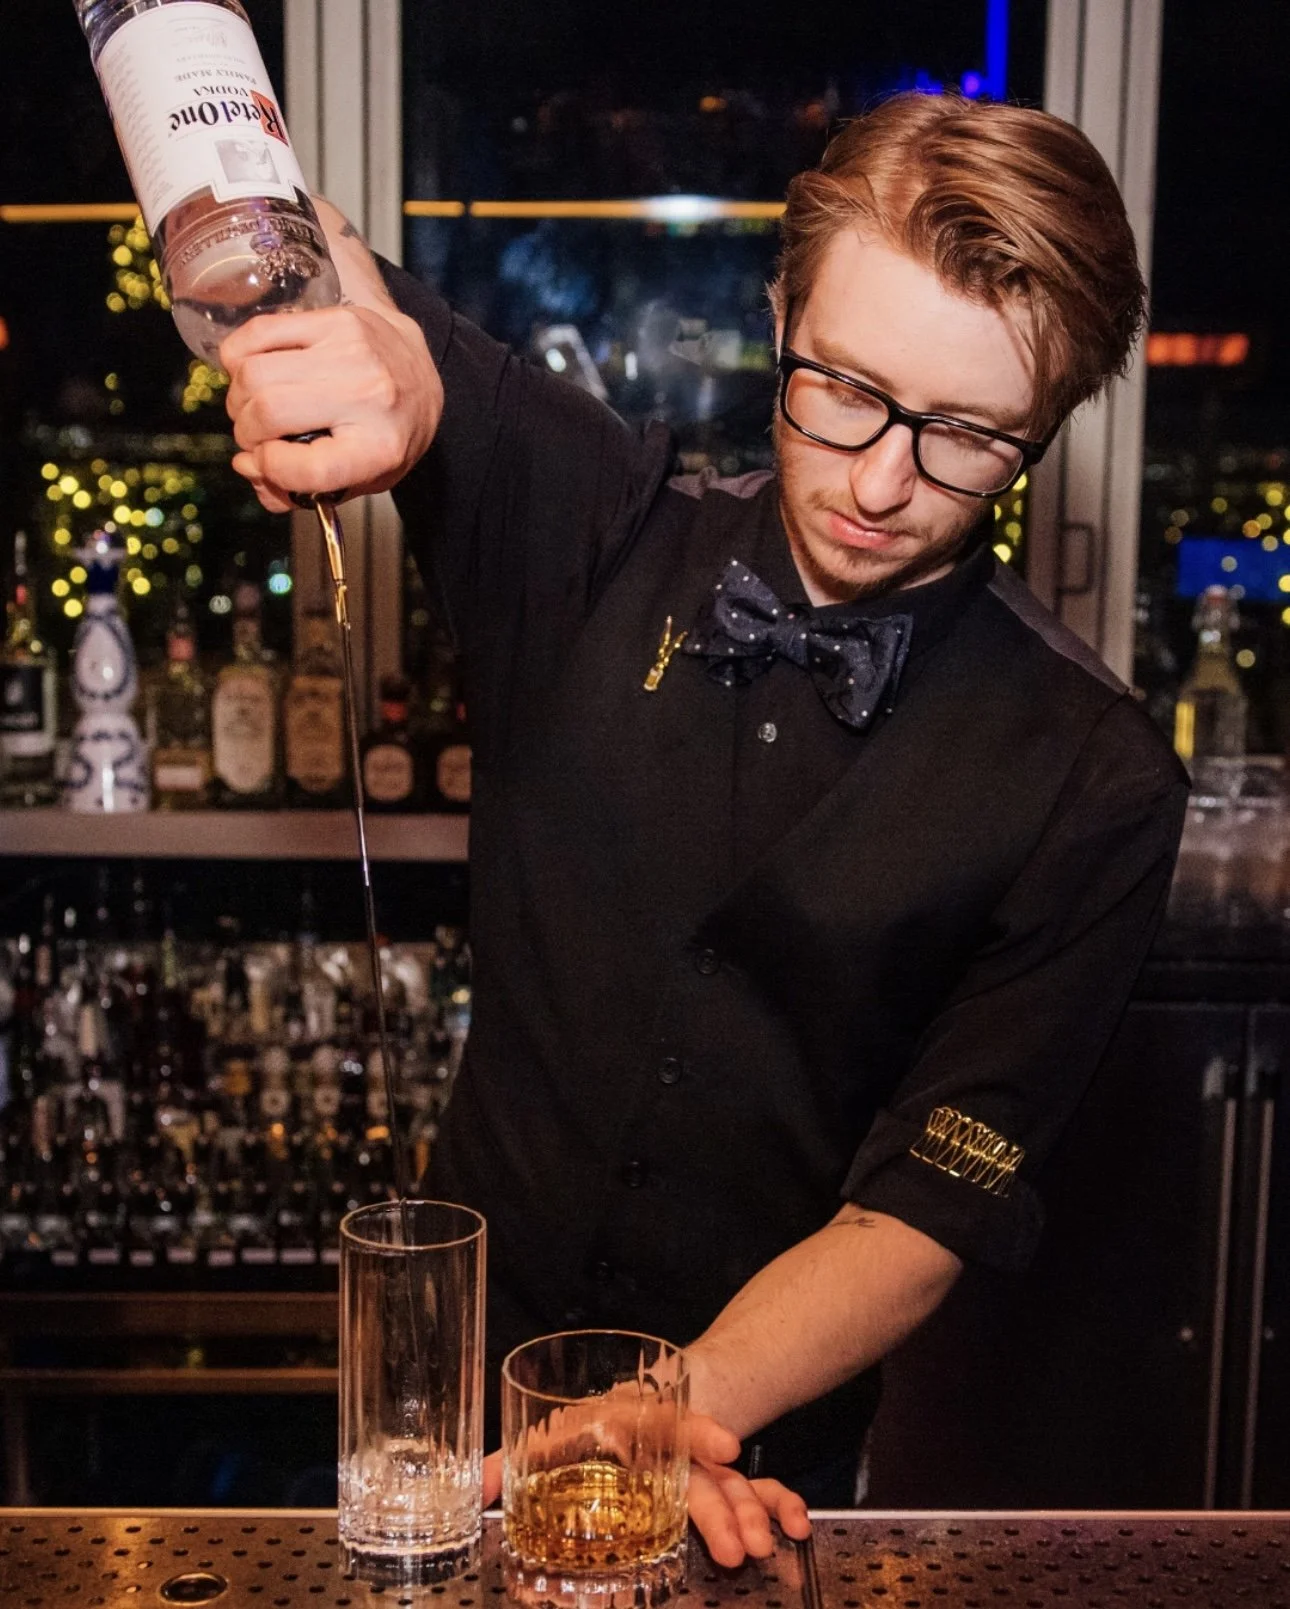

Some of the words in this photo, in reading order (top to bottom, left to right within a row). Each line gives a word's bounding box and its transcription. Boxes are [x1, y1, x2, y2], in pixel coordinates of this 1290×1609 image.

[174, 68, 213, 82] MADE
[215, 68, 258, 85] FAMILY
[192, 85, 249, 97] VODKA
[168, 101, 219, 131] One
